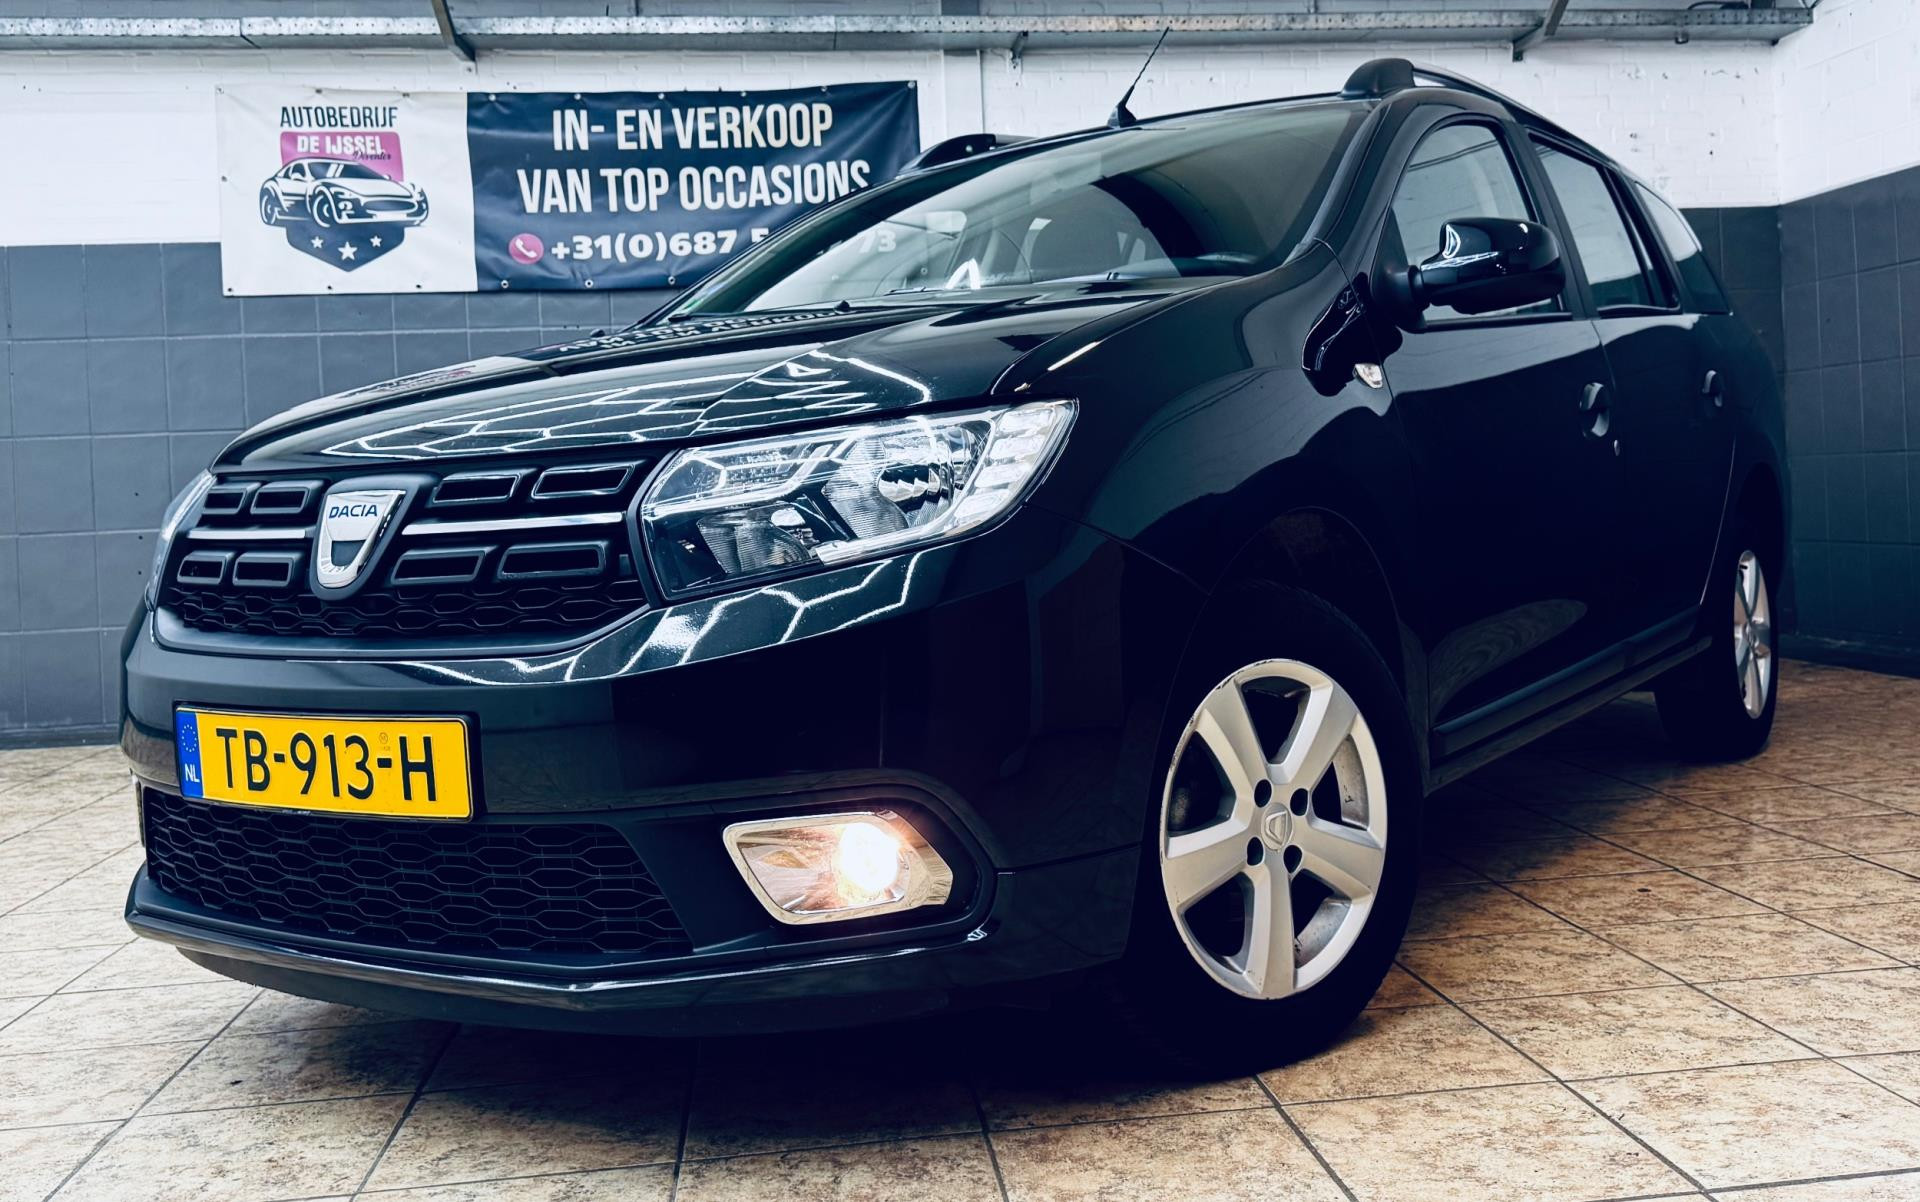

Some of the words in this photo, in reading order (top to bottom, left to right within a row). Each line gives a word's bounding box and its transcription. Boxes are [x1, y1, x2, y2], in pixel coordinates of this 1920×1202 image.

[280, 106, 398, 128] AUTOBEDRIJF
[552, 109, 604, 151] IN-
[616, 108, 662, 150] EN
[672, 103, 833, 150] VERKOOP
[297, 135, 320, 153] DE
[325, 135, 385, 155] IJSSEL
[517, 168, 592, 214] VAN
[600, 166, 669, 213] TOP
[679, 159, 870, 211] OCCASIONS
[551, 229, 737, 263] +31(0)687
[328, 504, 378, 519] DACIA
[185, 763, 200, 784] NL
[216, 727, 437, 801] TB-913-H
